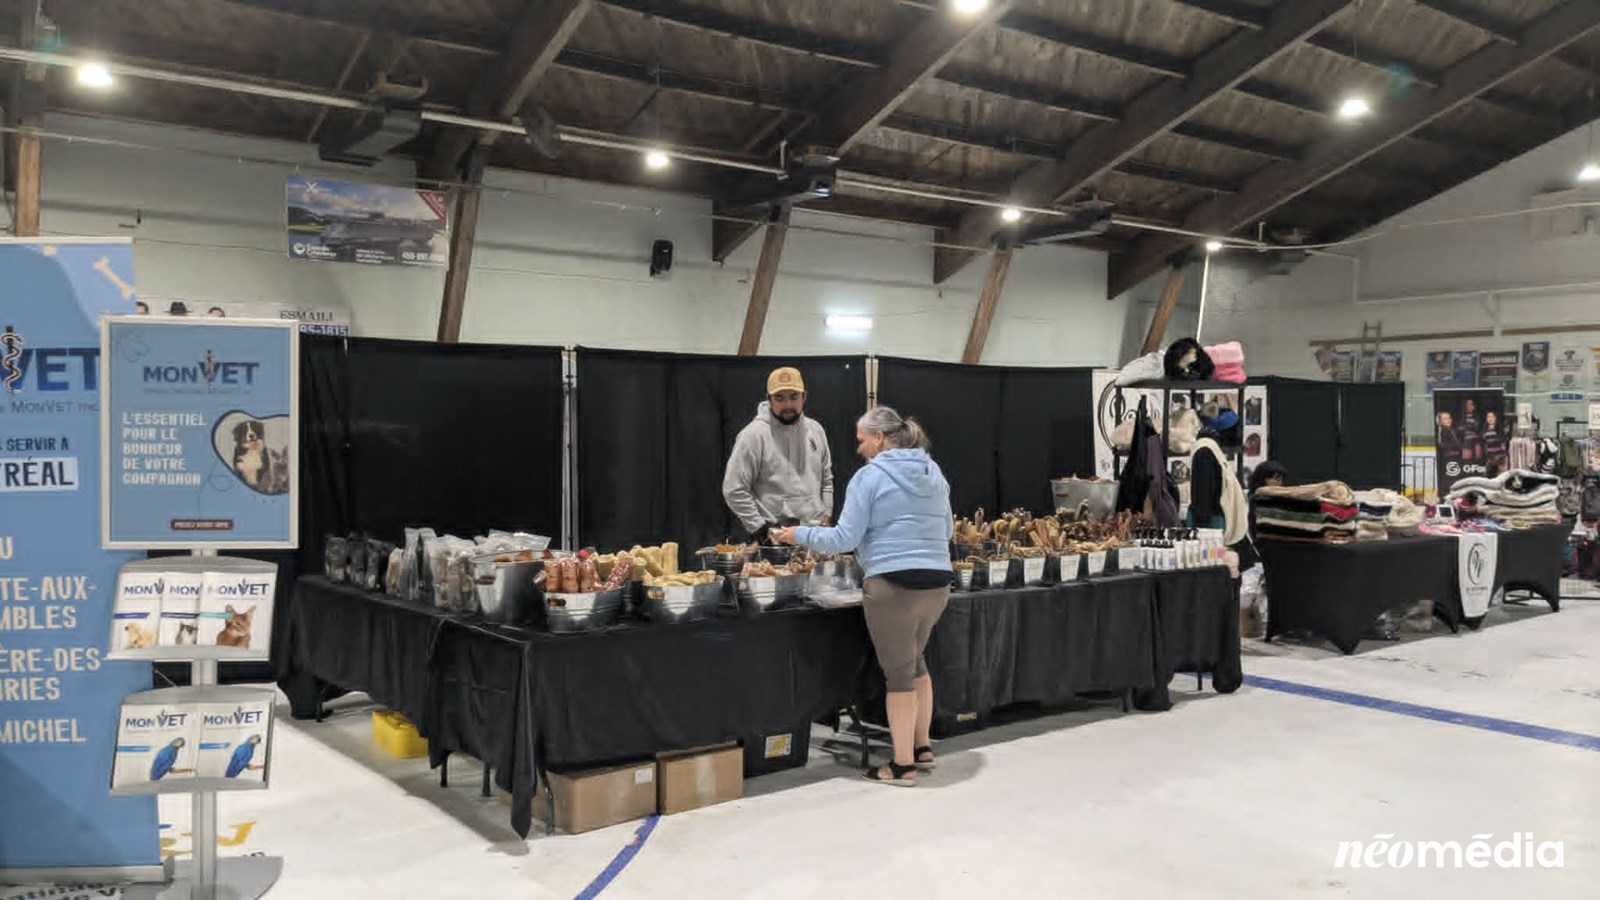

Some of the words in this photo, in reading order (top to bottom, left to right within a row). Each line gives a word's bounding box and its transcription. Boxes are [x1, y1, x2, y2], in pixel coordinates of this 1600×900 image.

[143, 361, 260, 385] MONVET
[122, 412, 207, 426] L'ESSENTIEL
[122, 427, 157, 440] POUR
[161, 428, 177, 440] LE
[6, 438, 56, 451] SERVIR
[122, 443, 182, 455] BONHEUR
[122, 458, 141, 470] DE
[144, 458, 187, 470] VOTRE
[0, 456, 74, 487] RÉAL
[122, 473, 201, 486] COMPAGNON
[125, 713, 187, 728] MONVET
[203, 711, 262, 726] MONVET
